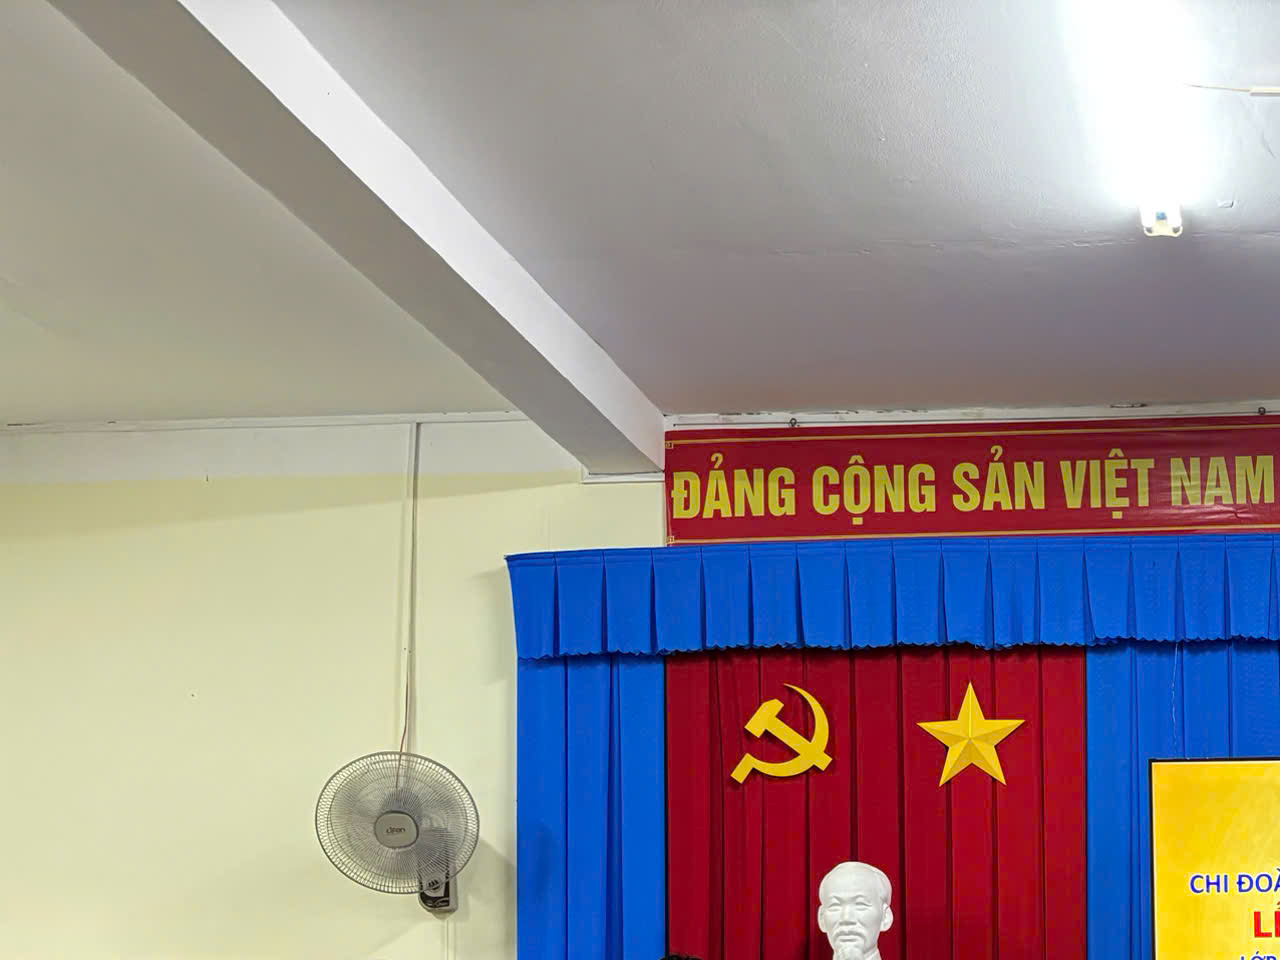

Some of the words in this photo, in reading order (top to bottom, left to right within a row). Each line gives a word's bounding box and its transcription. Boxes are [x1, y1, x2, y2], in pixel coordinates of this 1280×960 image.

[671, 453, 796, 519] ĐẢNG
[812, 455, 937, 525] CỘNG
[952, 445, 1045, 511] SẢN
[1059, 448, 1155, 519] VIỆT
[1170, 454, 1274, 507] NAM
[1190, 874, 1228, 893] CHI
